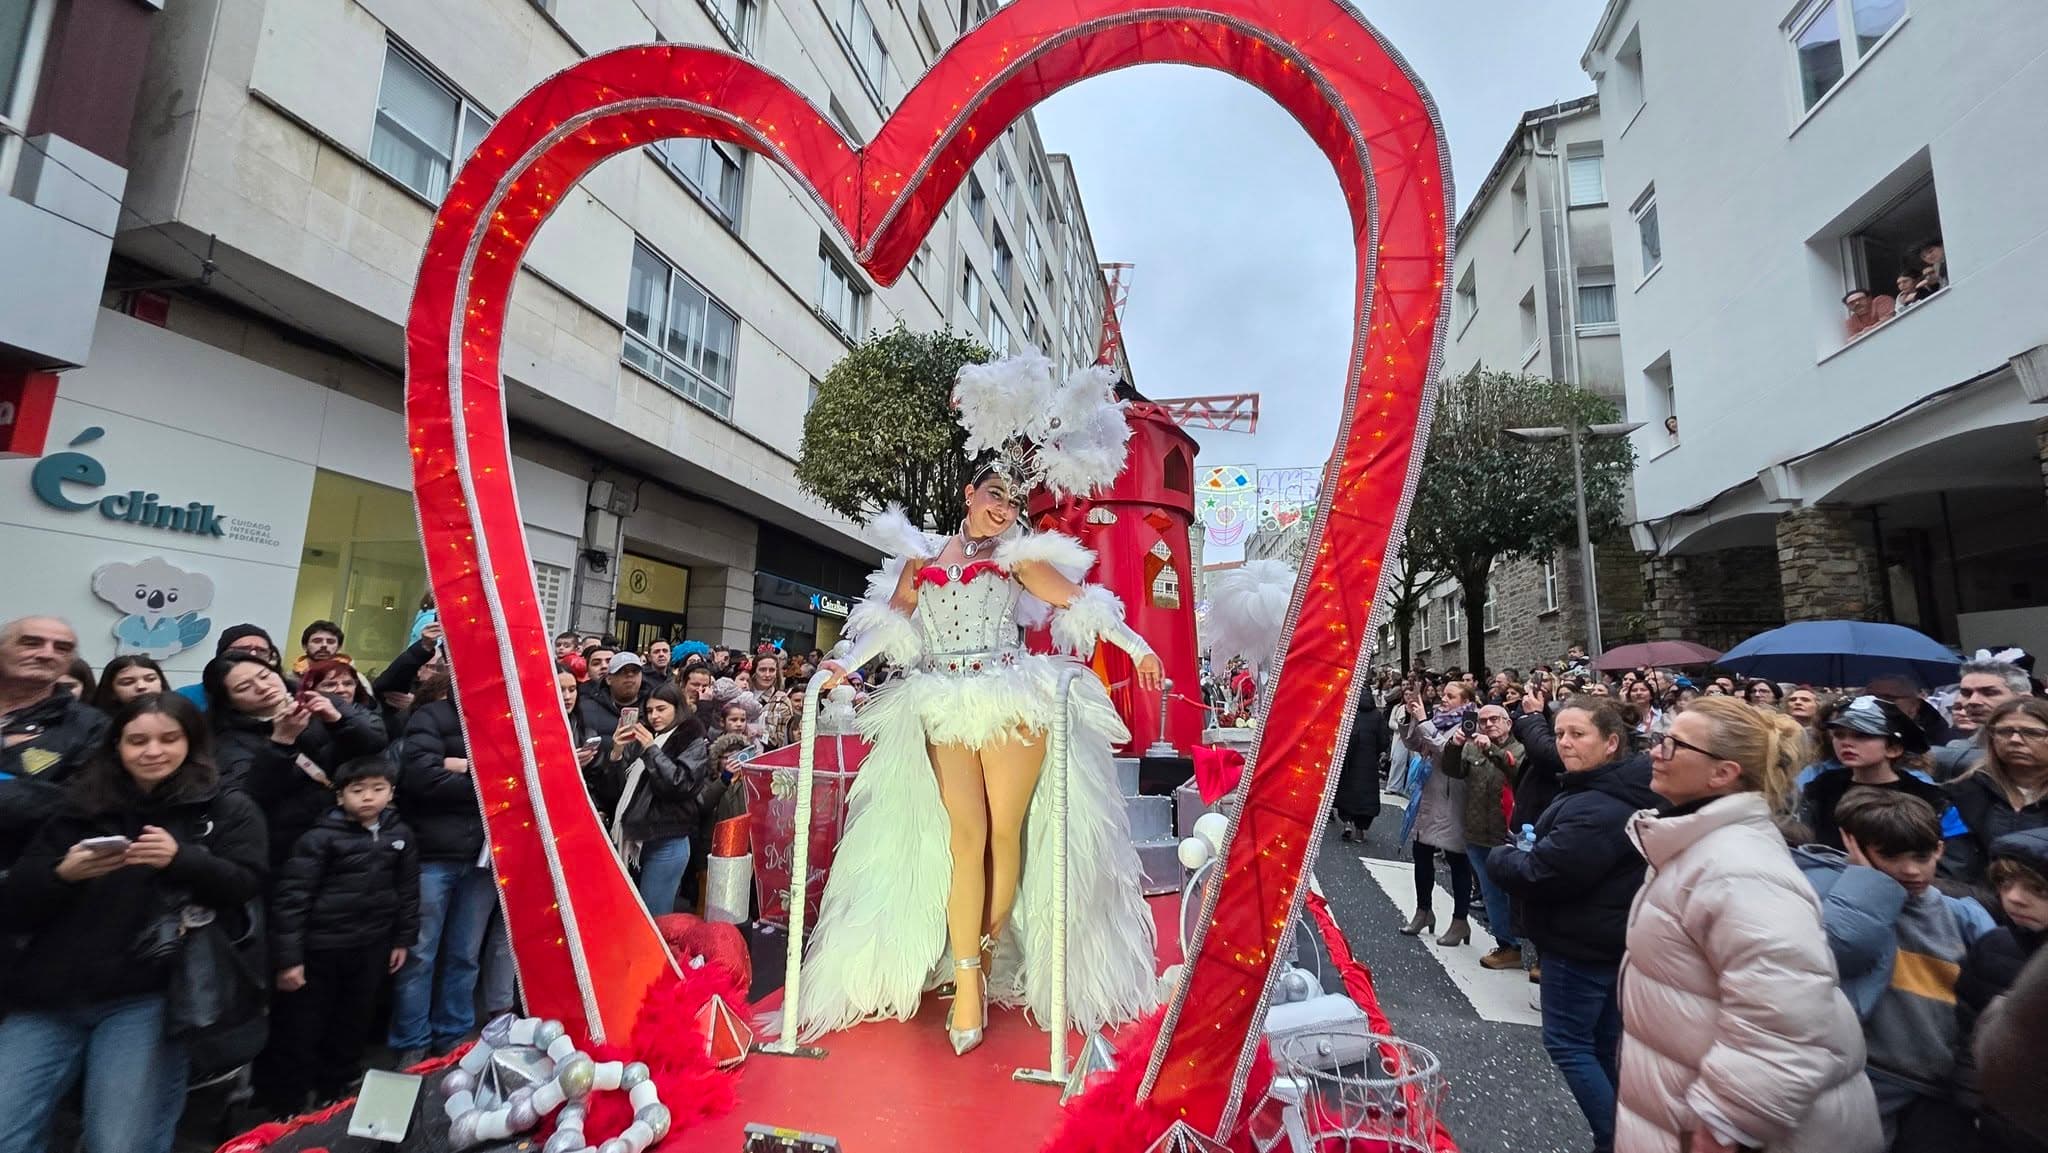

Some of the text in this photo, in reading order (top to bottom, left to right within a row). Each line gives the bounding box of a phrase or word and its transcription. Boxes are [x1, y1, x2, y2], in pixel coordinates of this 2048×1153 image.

[230, 525, 270, 539] INTEGRAL
[231, 518, 271, 532] CUIDADO
[634, 573, 643, 590] 8
